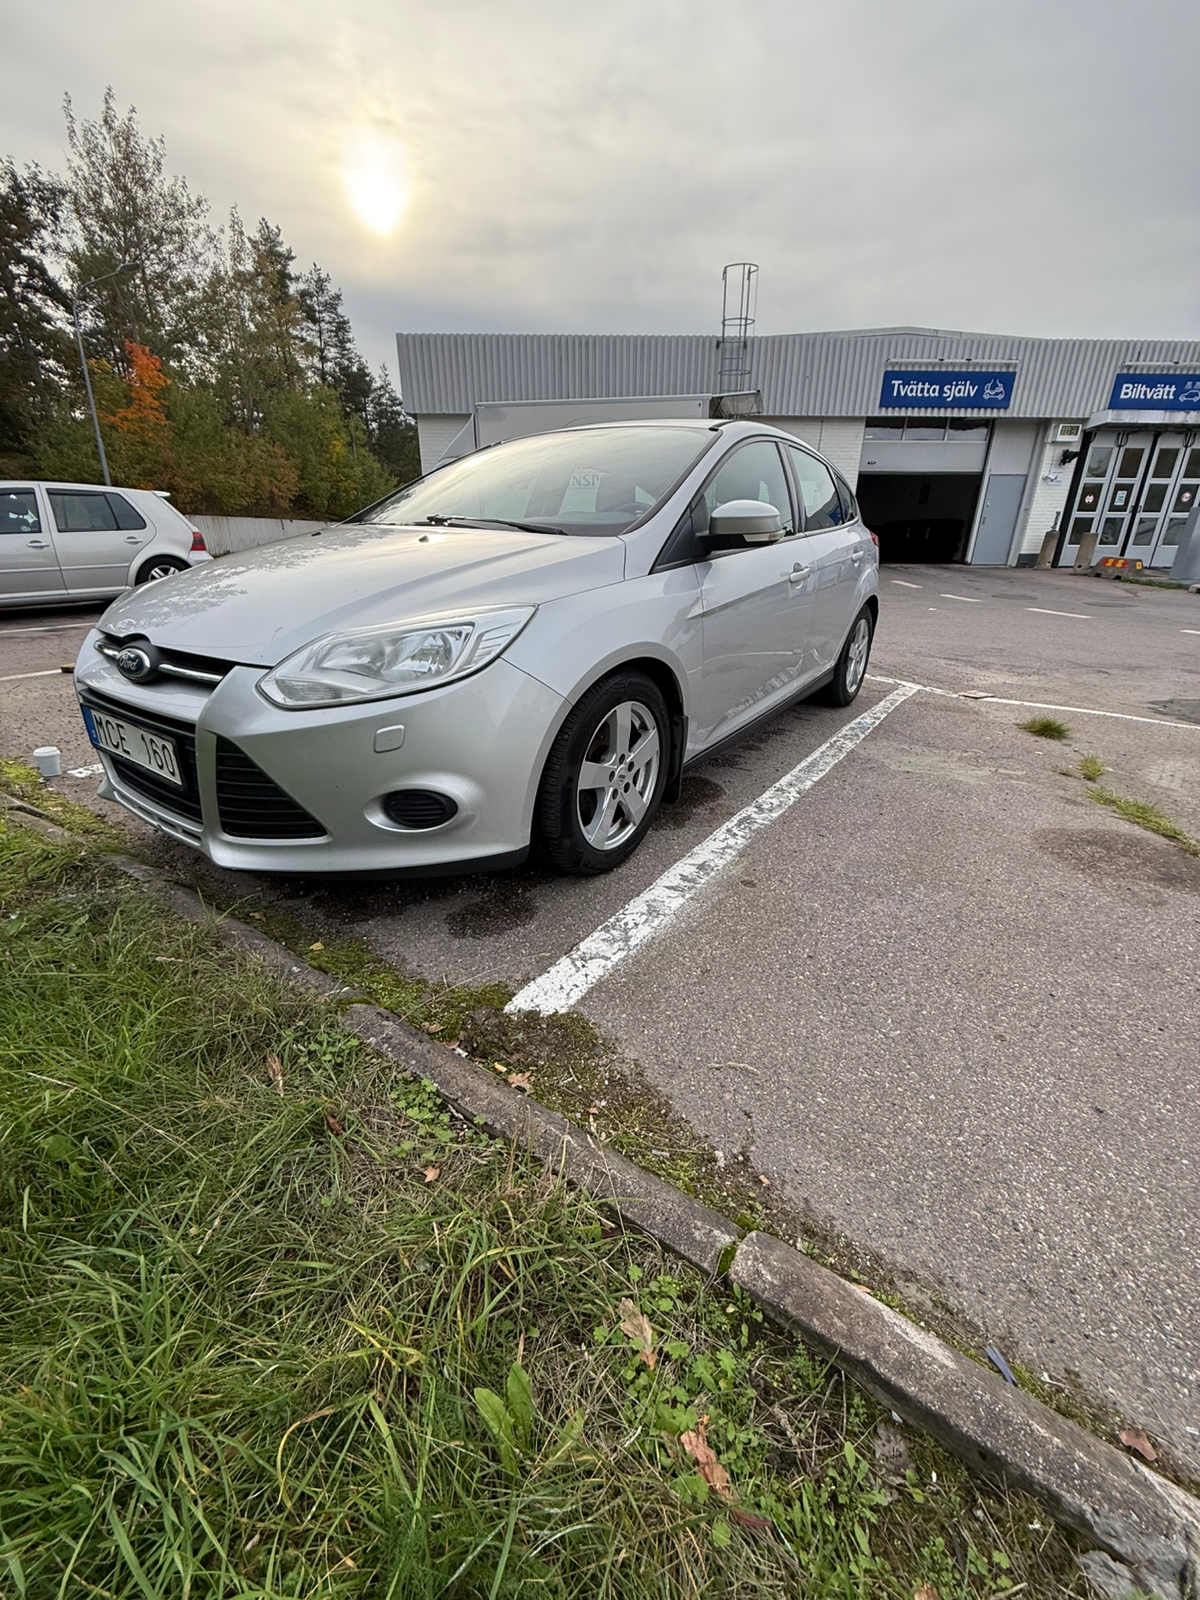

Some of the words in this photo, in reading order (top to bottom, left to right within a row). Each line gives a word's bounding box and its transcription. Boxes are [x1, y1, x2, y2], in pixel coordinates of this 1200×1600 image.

[891, 380, 940, 398] Tvätta
[942, 380, 979, 402] själv
[1119, 383, 1177, 400] Biltvätt
[119, 651, 139, 671] Ford
[93, 713, 132, 756] MCE
[141, 732, 176, 777] 160
